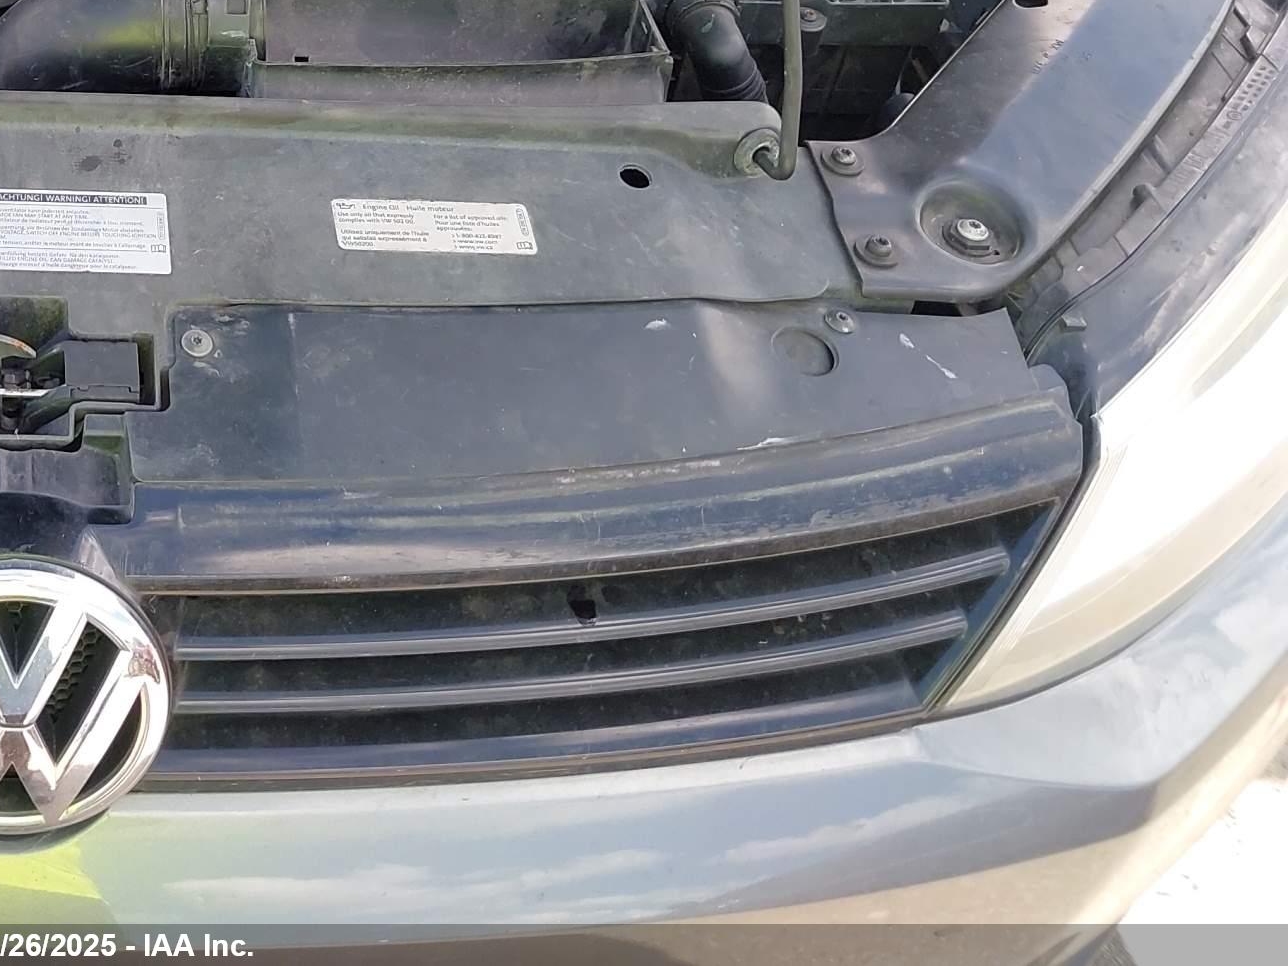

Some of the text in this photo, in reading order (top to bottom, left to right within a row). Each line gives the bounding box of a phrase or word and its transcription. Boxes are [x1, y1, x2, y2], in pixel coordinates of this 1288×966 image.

[46, 195, 91, 203] WARNING!
[93, 196, 145, 204] ATTENTION!
[363, 204, 387, 212] Engine
